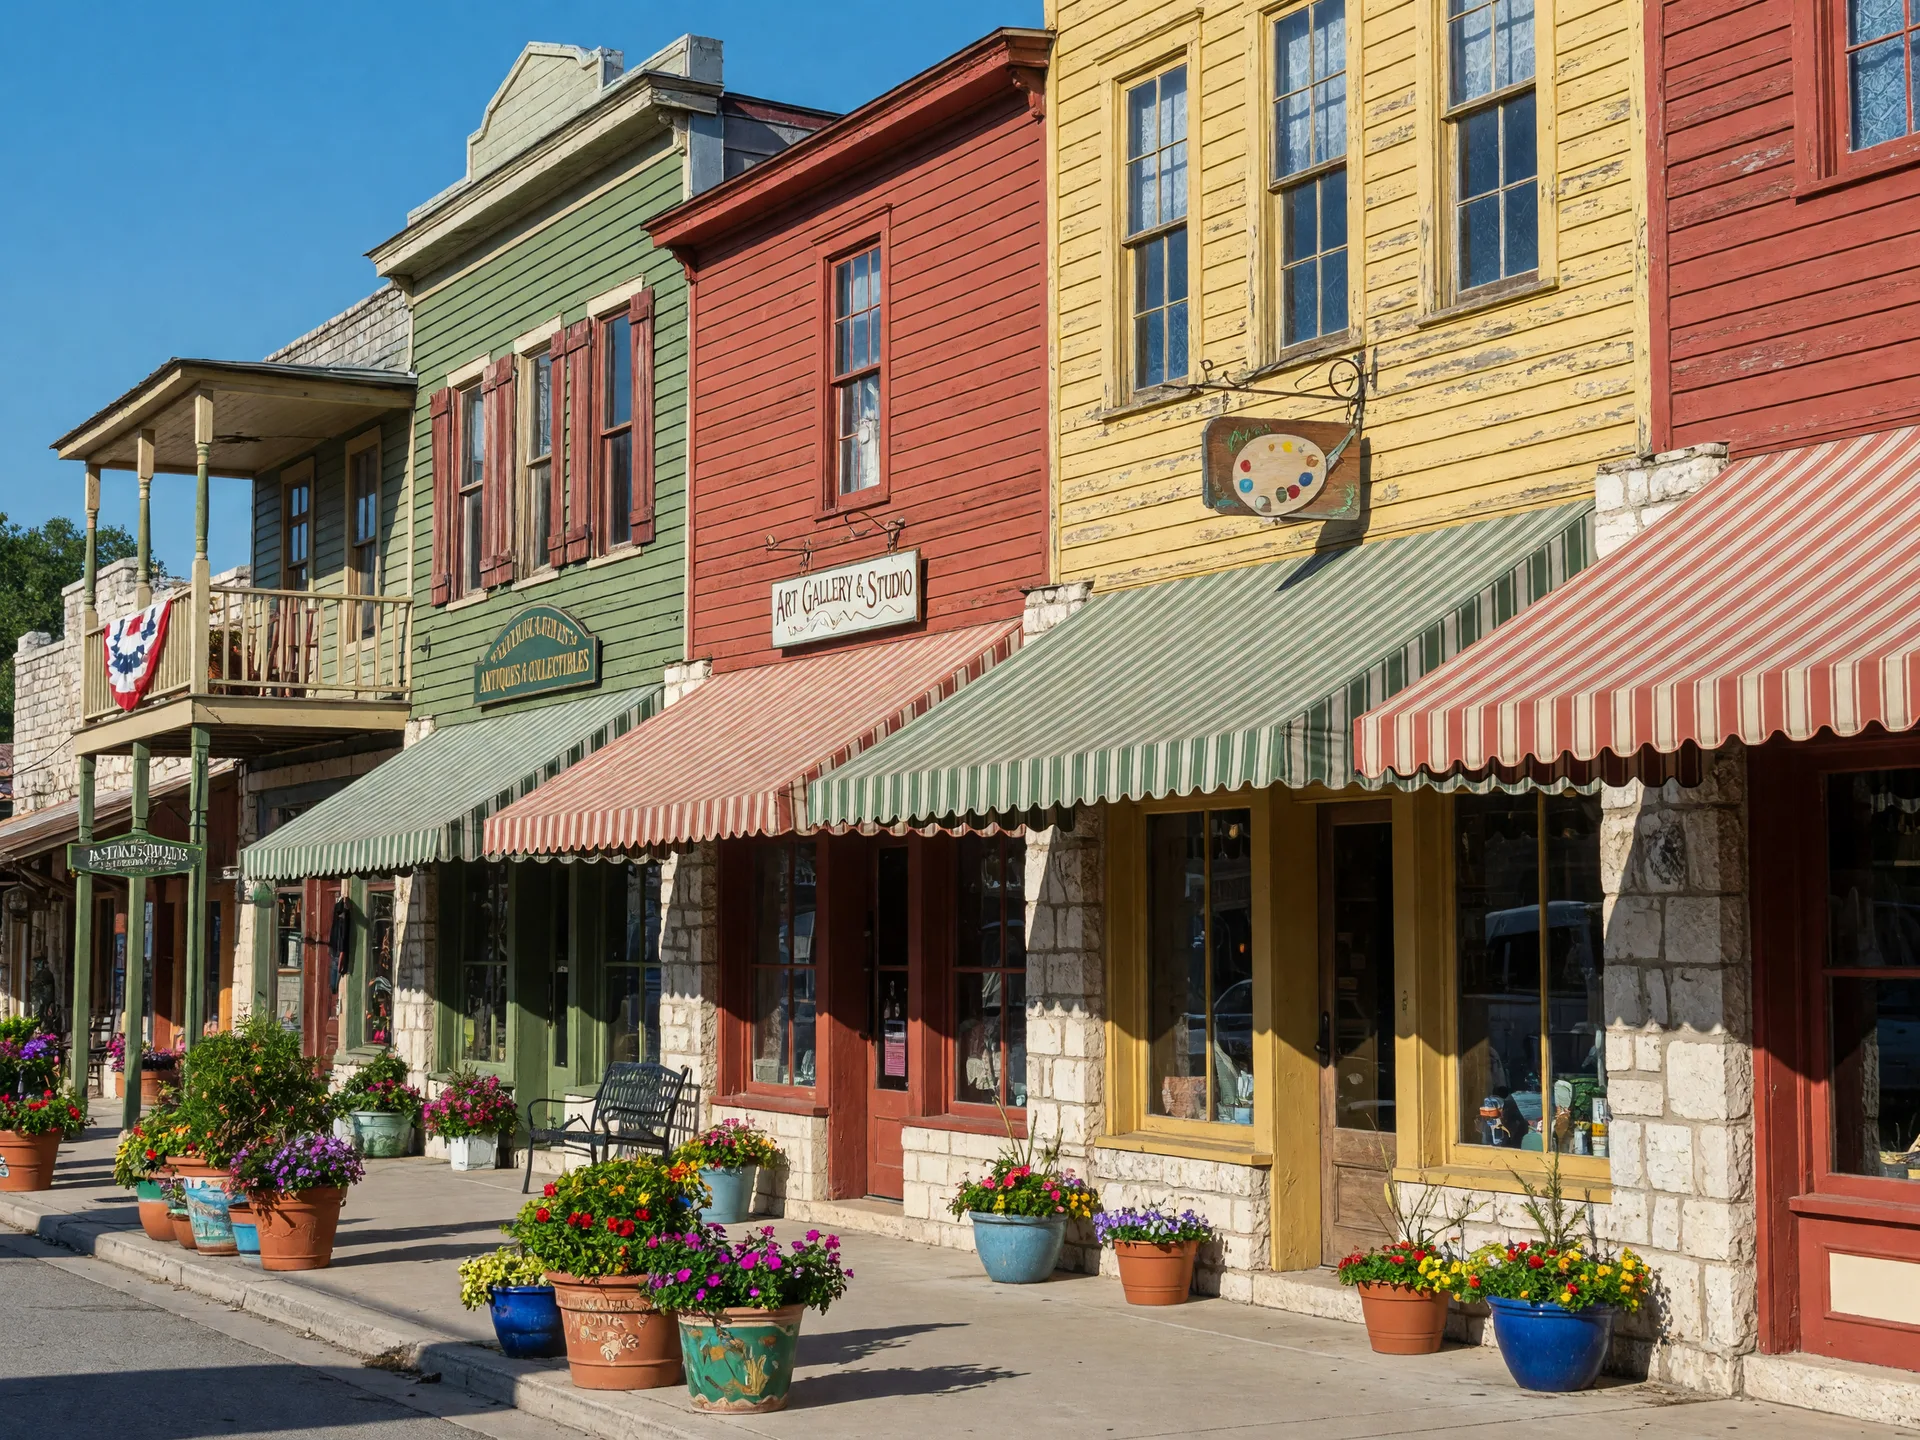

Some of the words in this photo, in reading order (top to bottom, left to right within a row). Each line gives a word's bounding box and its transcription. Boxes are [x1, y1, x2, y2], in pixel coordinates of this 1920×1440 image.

[776, 588, 798, 626] ART
[802, 575, 853, 614] GALLERY
[856, 573, 865, 599] &
[866, 568, 913, 608] STUDIO
[480, 664, 520, 693] ANTIQUES
